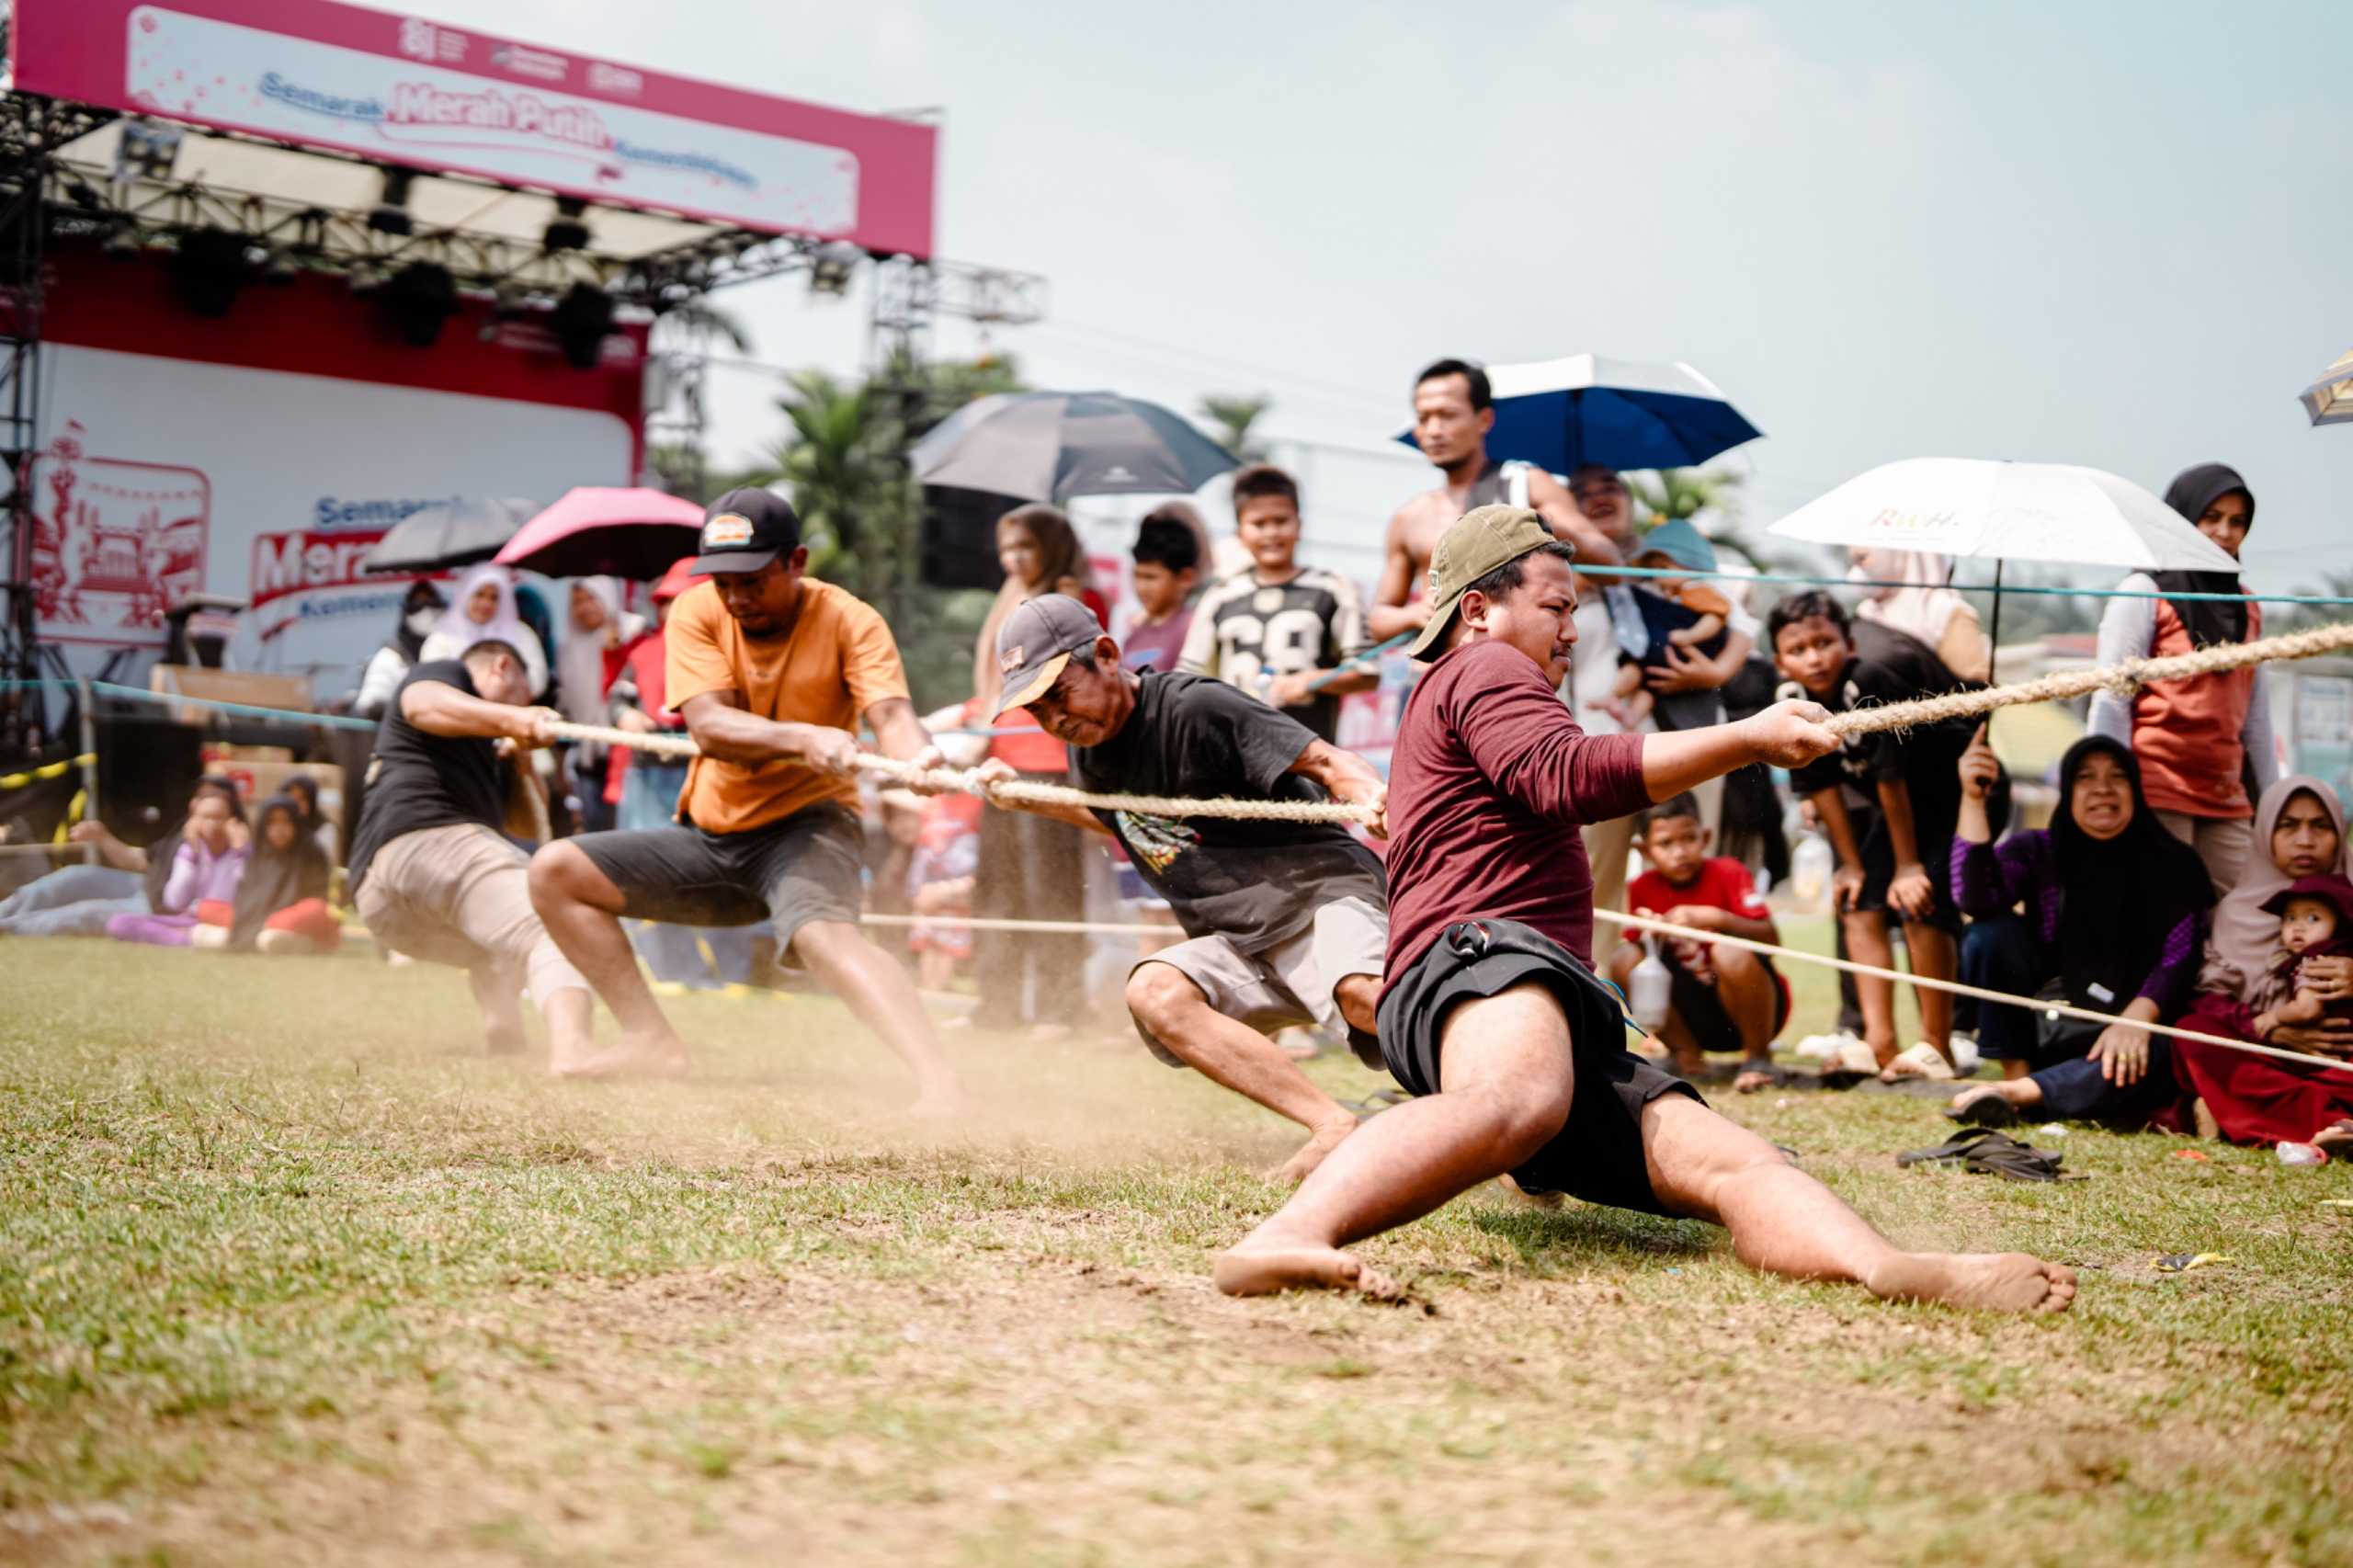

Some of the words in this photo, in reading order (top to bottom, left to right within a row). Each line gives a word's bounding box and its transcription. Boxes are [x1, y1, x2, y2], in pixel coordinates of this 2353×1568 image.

[261, 72, 383, 120] Semarak
[392, 82, 514, 130] Merah
[515, 94, 608, 150] Putih
[315, 496, 462, 528] Sema
